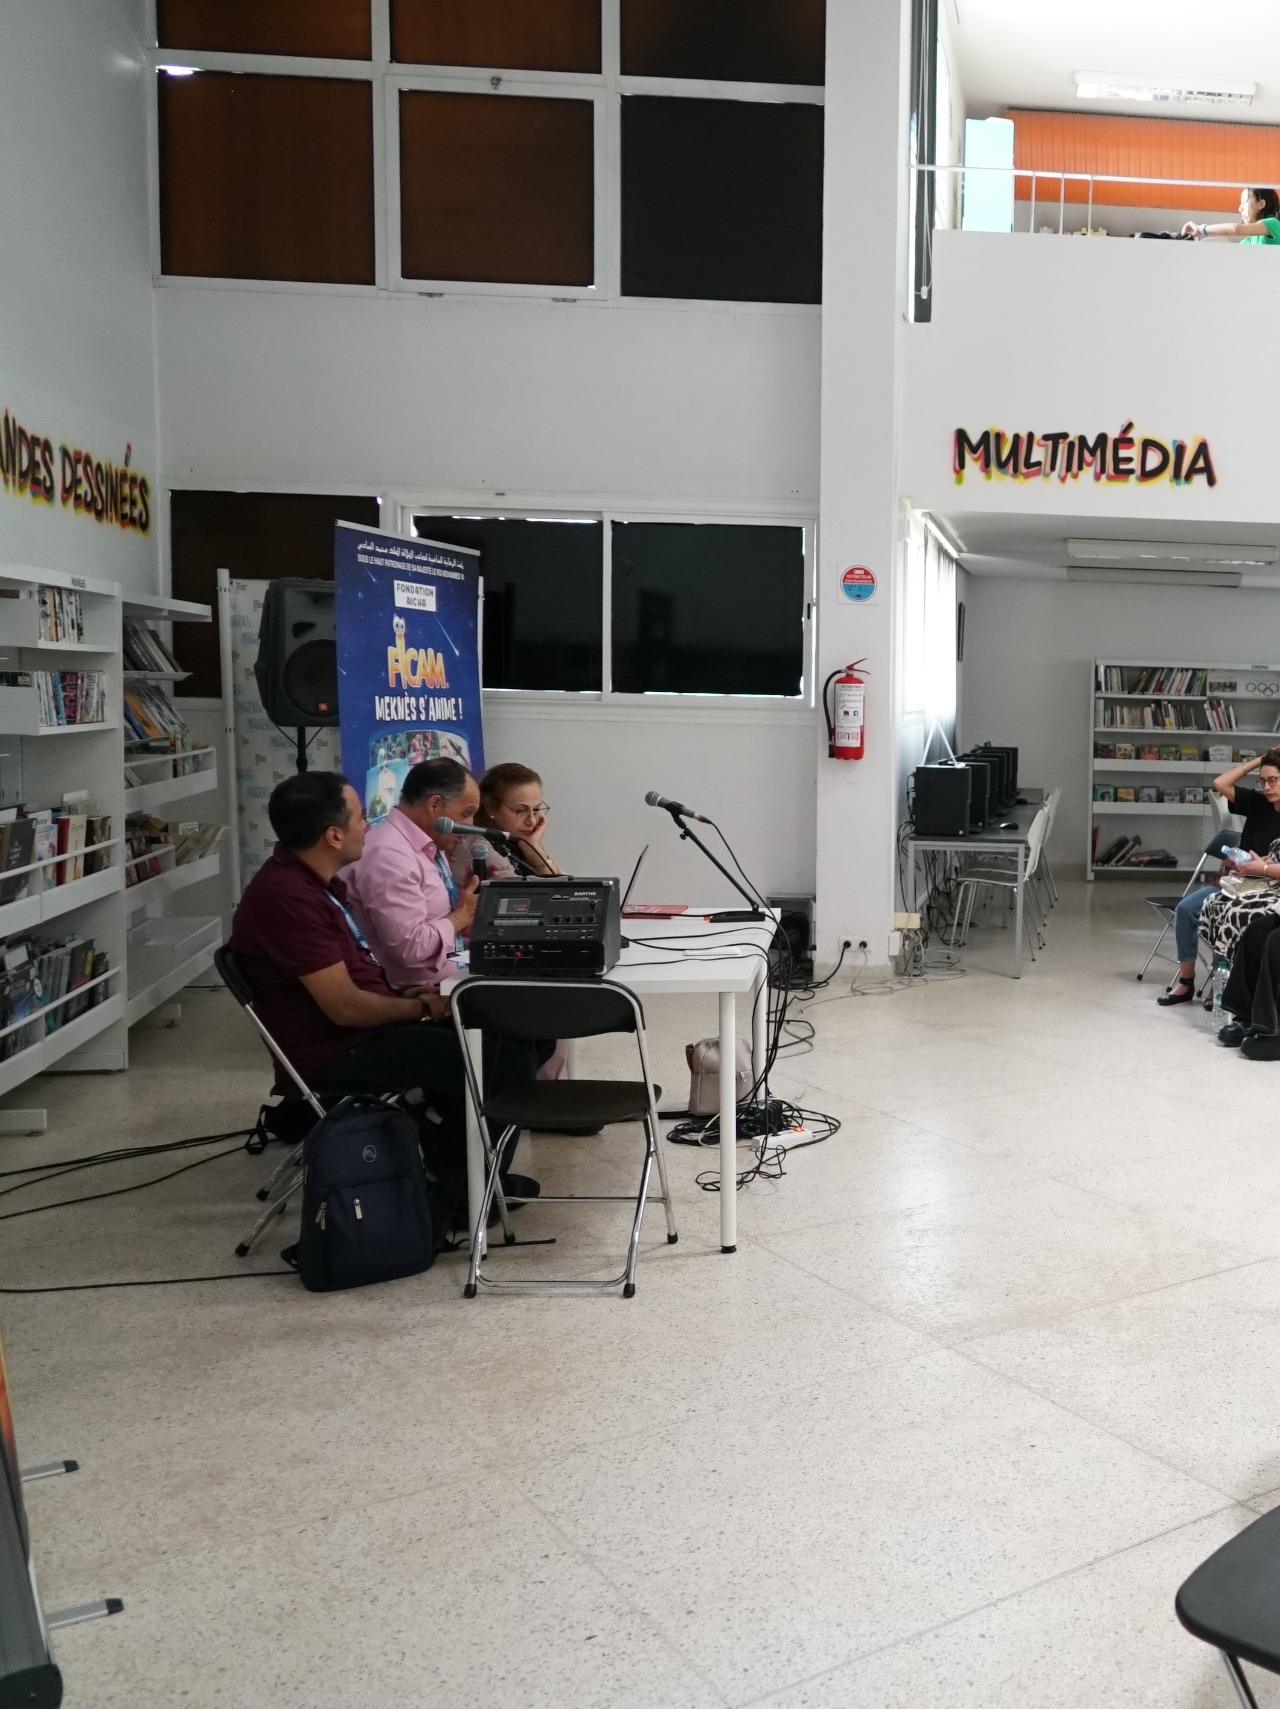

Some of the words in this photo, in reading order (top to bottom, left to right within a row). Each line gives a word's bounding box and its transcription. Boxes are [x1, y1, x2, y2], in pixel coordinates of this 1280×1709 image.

[954, 420, 1217, 487] MULTIMÉDIA
[59, 441, 150, 535] DESSINÉES
[357, 553, 369, 564] SOUS
[396, 583, 434, 597] FONDATION
[387, 634, 446, 690] FICAM
[375, 691, 417, 721] MEKNÈS
